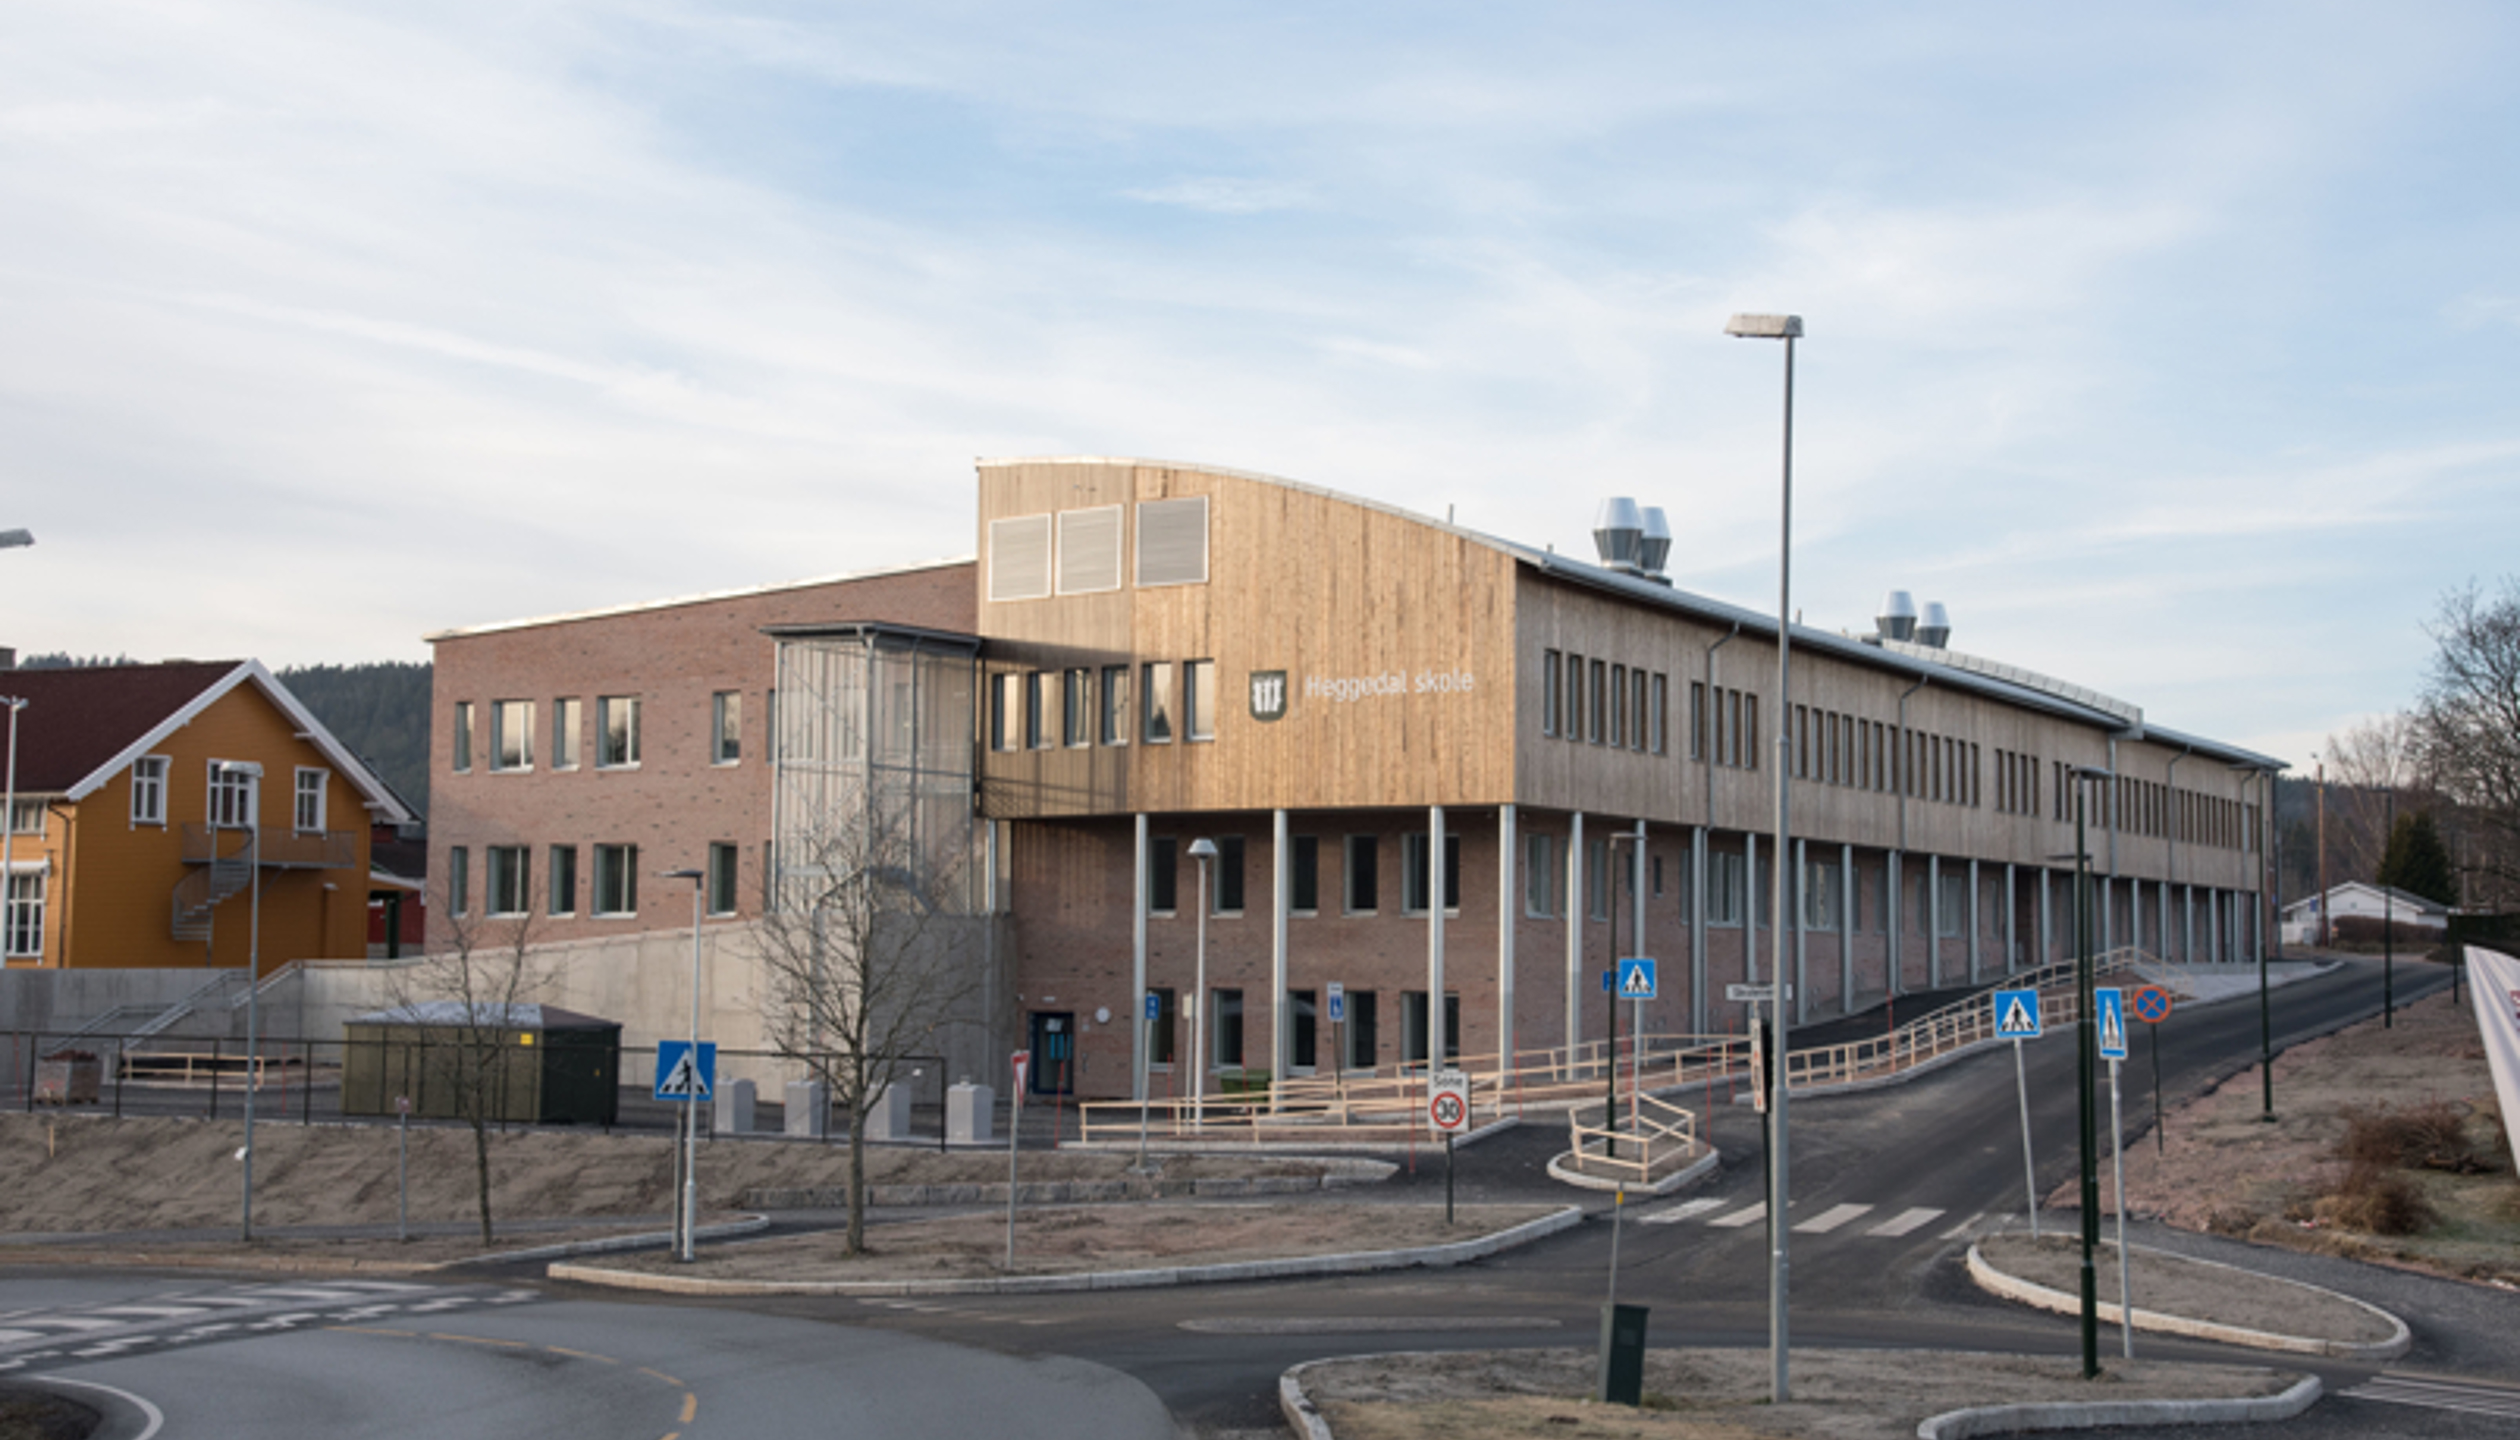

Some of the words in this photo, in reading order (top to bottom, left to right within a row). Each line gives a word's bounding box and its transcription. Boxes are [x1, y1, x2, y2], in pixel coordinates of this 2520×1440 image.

[1305, 670, 1408, 702] Heggedal
[1414, 667, 1474, 693] skole
[1437, 1100, 1459, 1120] 30
